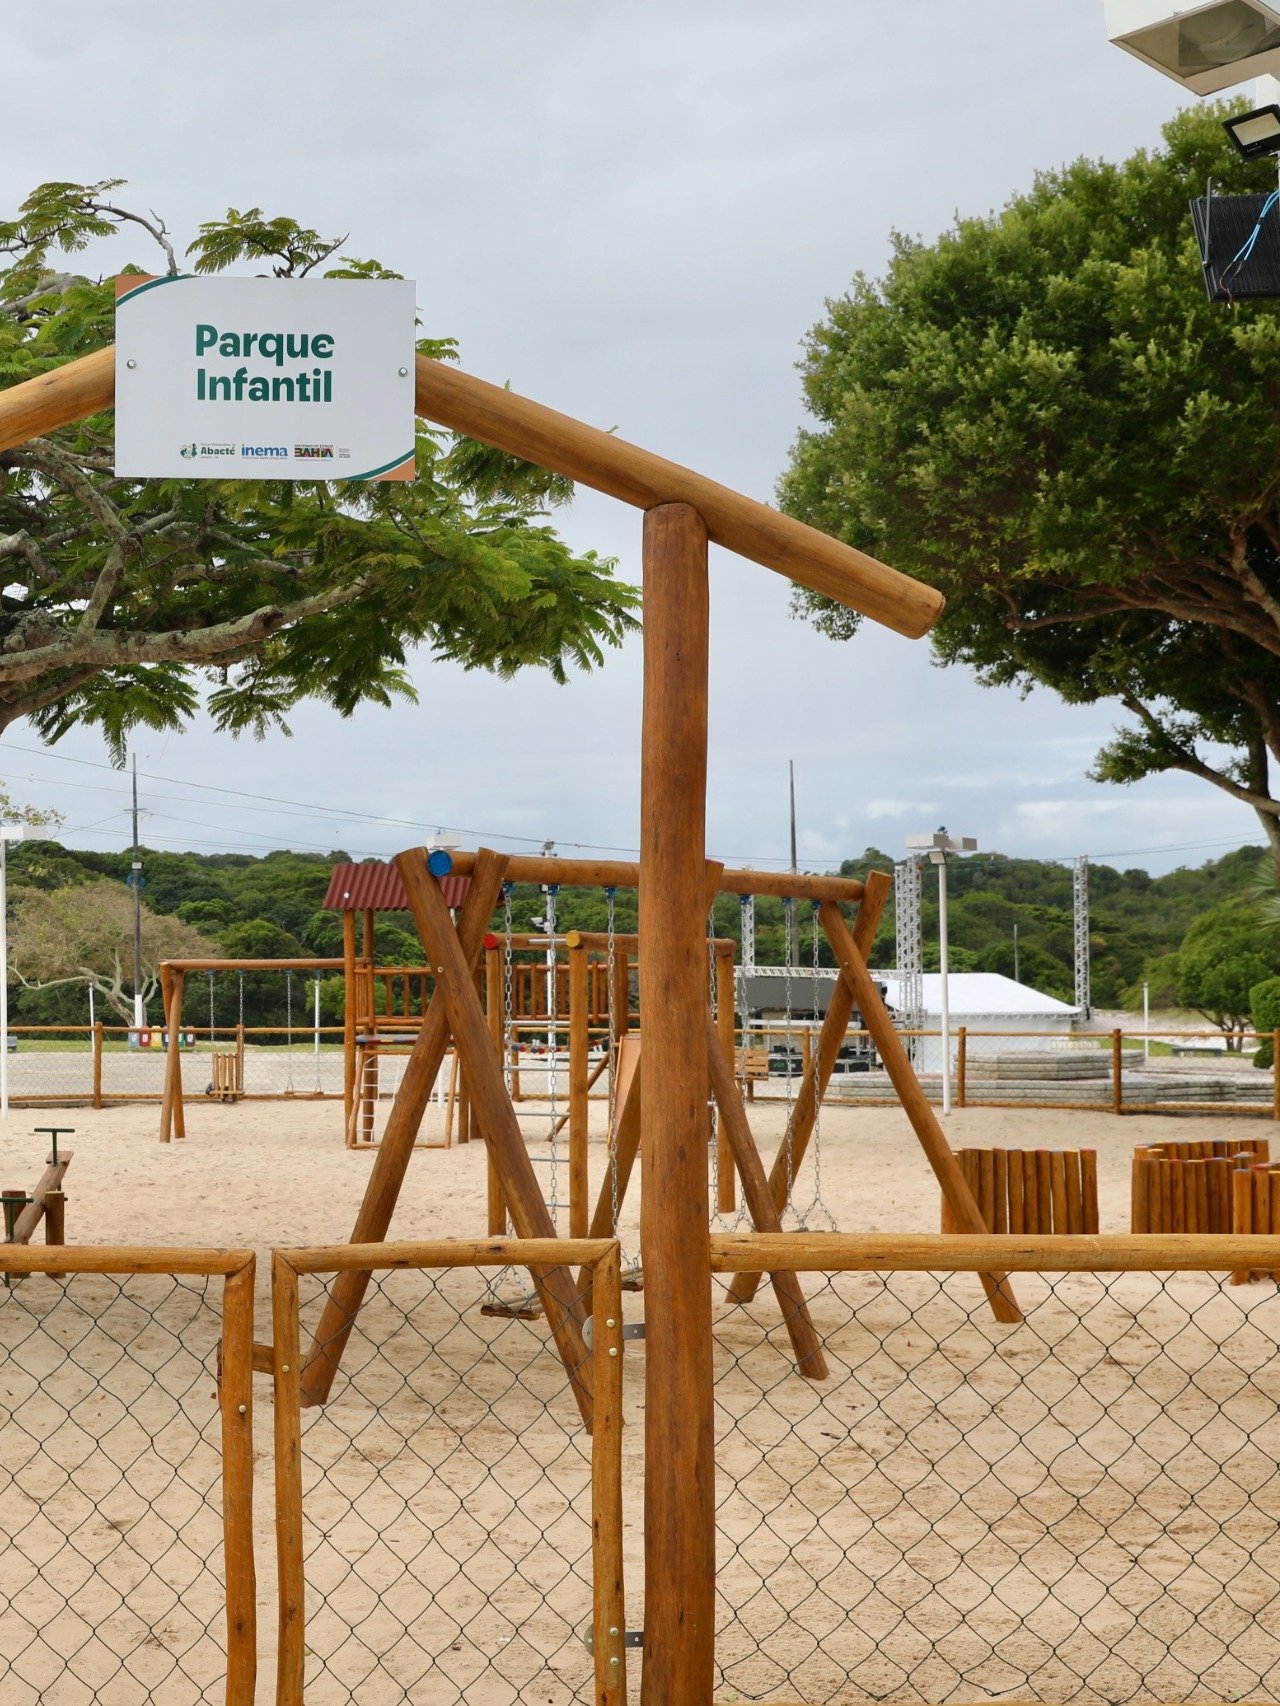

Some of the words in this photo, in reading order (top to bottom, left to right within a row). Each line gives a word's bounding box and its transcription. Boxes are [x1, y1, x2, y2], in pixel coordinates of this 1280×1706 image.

[196, 324, 335, 366] Parque
[197, 366, 332, 402] Infantil
[241, 443, 288, 457] inema
[294, 447, 333, 458] BAHIA
